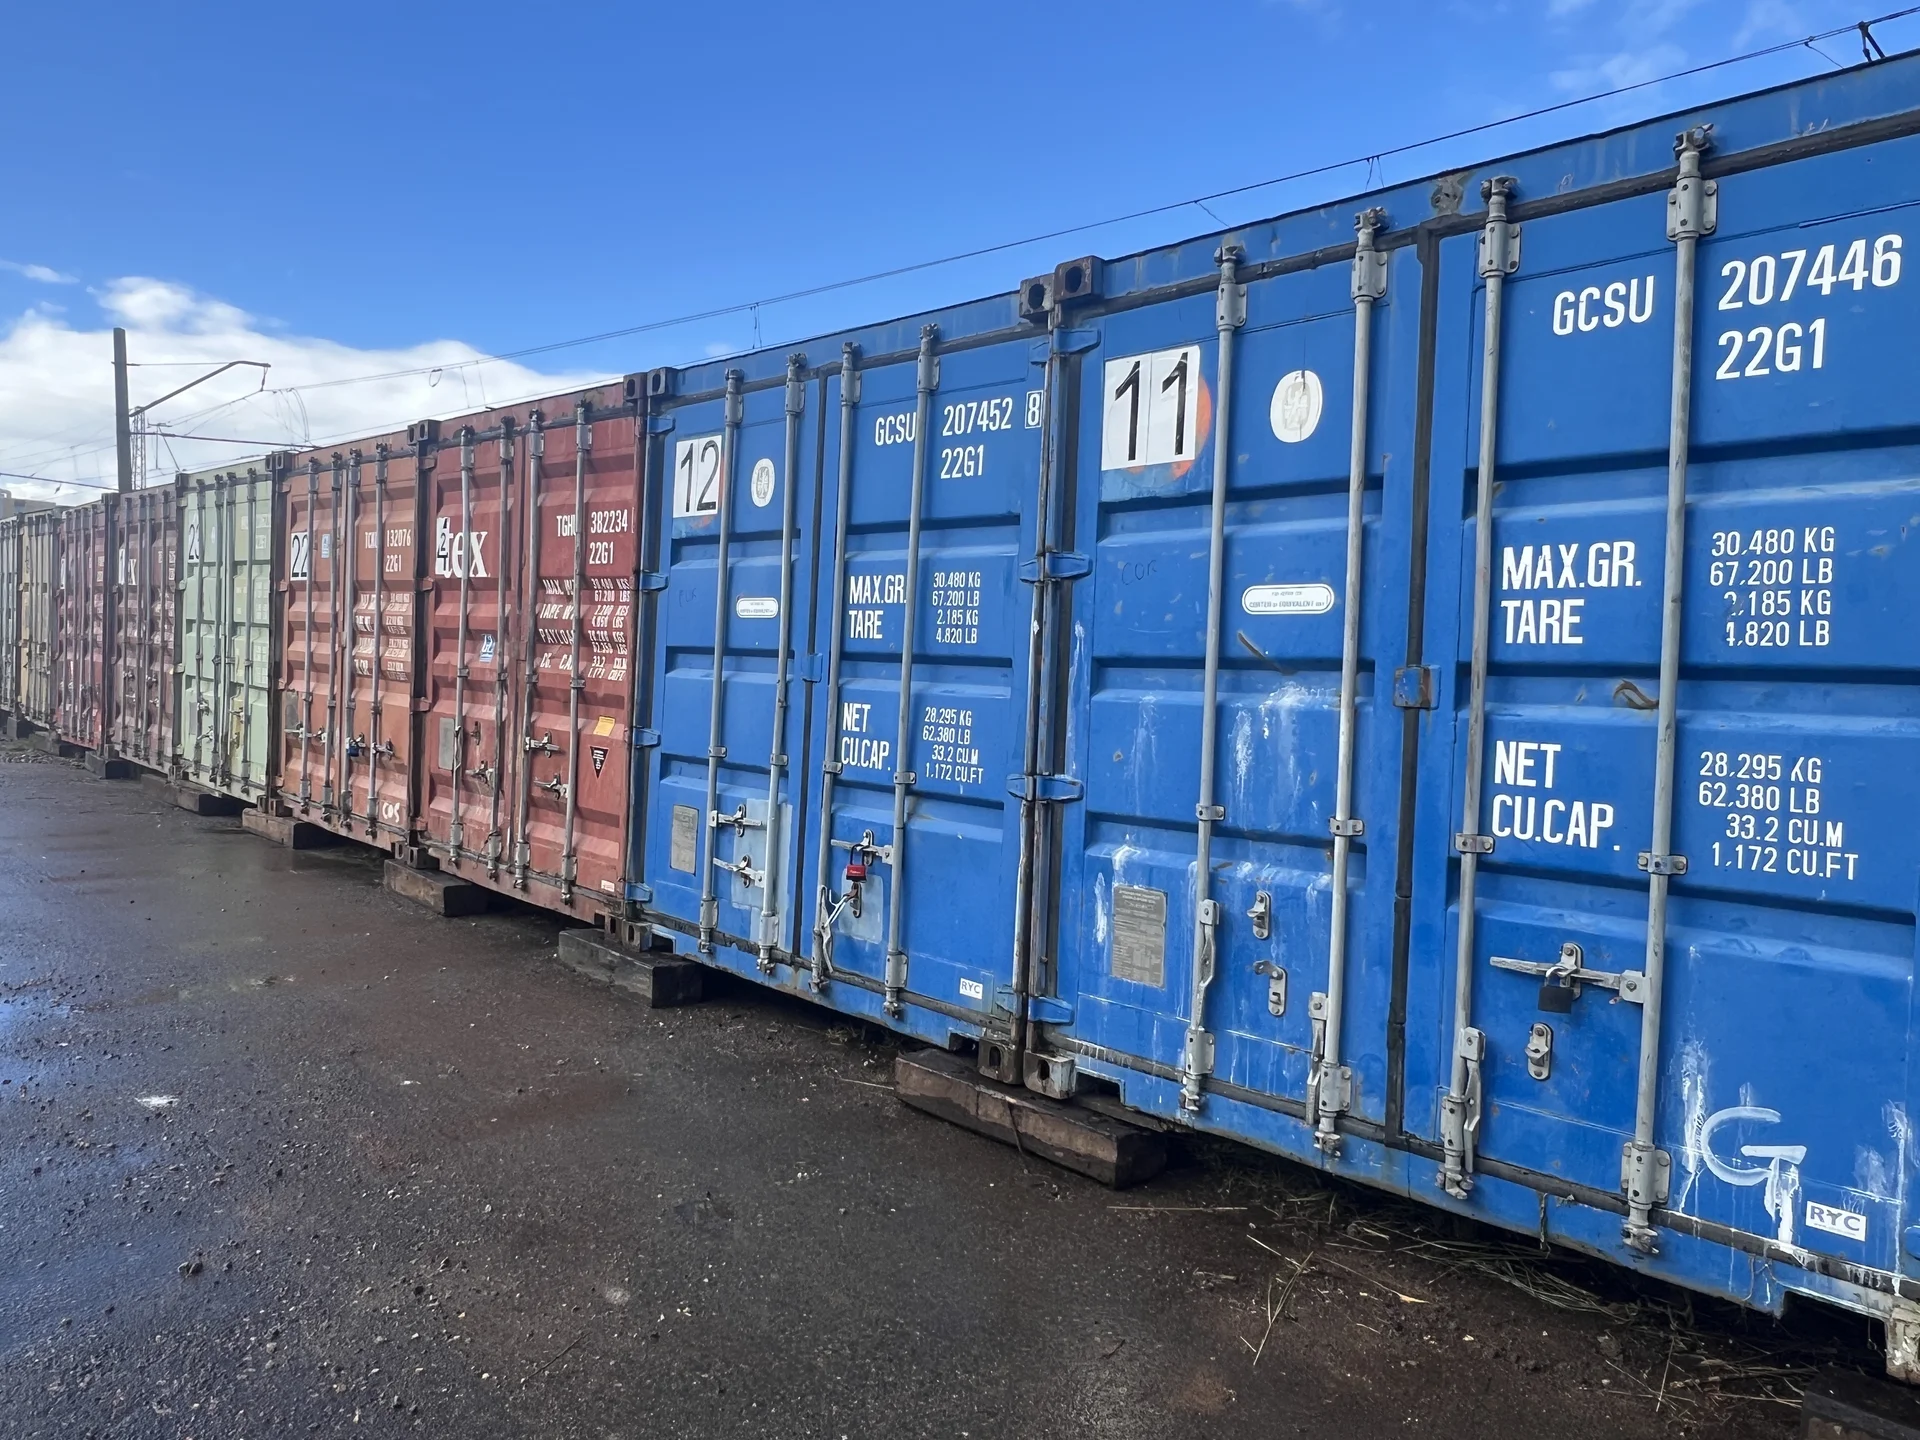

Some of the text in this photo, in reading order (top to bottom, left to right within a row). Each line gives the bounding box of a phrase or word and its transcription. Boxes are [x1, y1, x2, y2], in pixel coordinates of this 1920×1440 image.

[1552, 233, 1903, 336] GCSU 207446
[1715, 318, 1826, 380] 22G1
[875, 392, 1042, 446] GCSU 207452 8
[1115, 352, 1188, 461] 11
[940, 444, 984, 479] 22G1
[680, 440, 720, 513] 12
[590, 508, 628, 534] 382234
[386, 528, 412, 547] 132076
[588, 541, 614, 565] 22G1
[1502, 540, 1642, 591] MAX.GR.
[1803, 526, 1835, 553] KG
[967, 571, 981, 588] KG
[1802, 557, 1833, 584] LB
[967, 590, 980, 607] LB
[848, 609, 884, 639] TARE
[965, 609, 979, 626] KG
[1500, 598, 1585, 644] TARE
[1800, 589, 1831, 616] KG
[965, 627, 978, 644] LB
[1799, 620, 1830, 646] LB
[842, 702, 872, 733] NET
[959, 709, 972, 727] KG
[957, 728, 971, 745] LB
[956, 747, 979, 765] CU.M
[1494, 740, 1562, 789] NET
[1790, 756, 1822, 784] KG
[954, 764, 984, 784] CU.FT
[1789, 787, 1820, 814] LB
[1725, 812, 1779, 843] 33.2
[1788, 818, 1843, 849] CU.M
[1786, 847, 1859, 881] CU.FT
[961, 980, 981, 994] RYC
[1810, 1205, 1861, 1232] RYC
